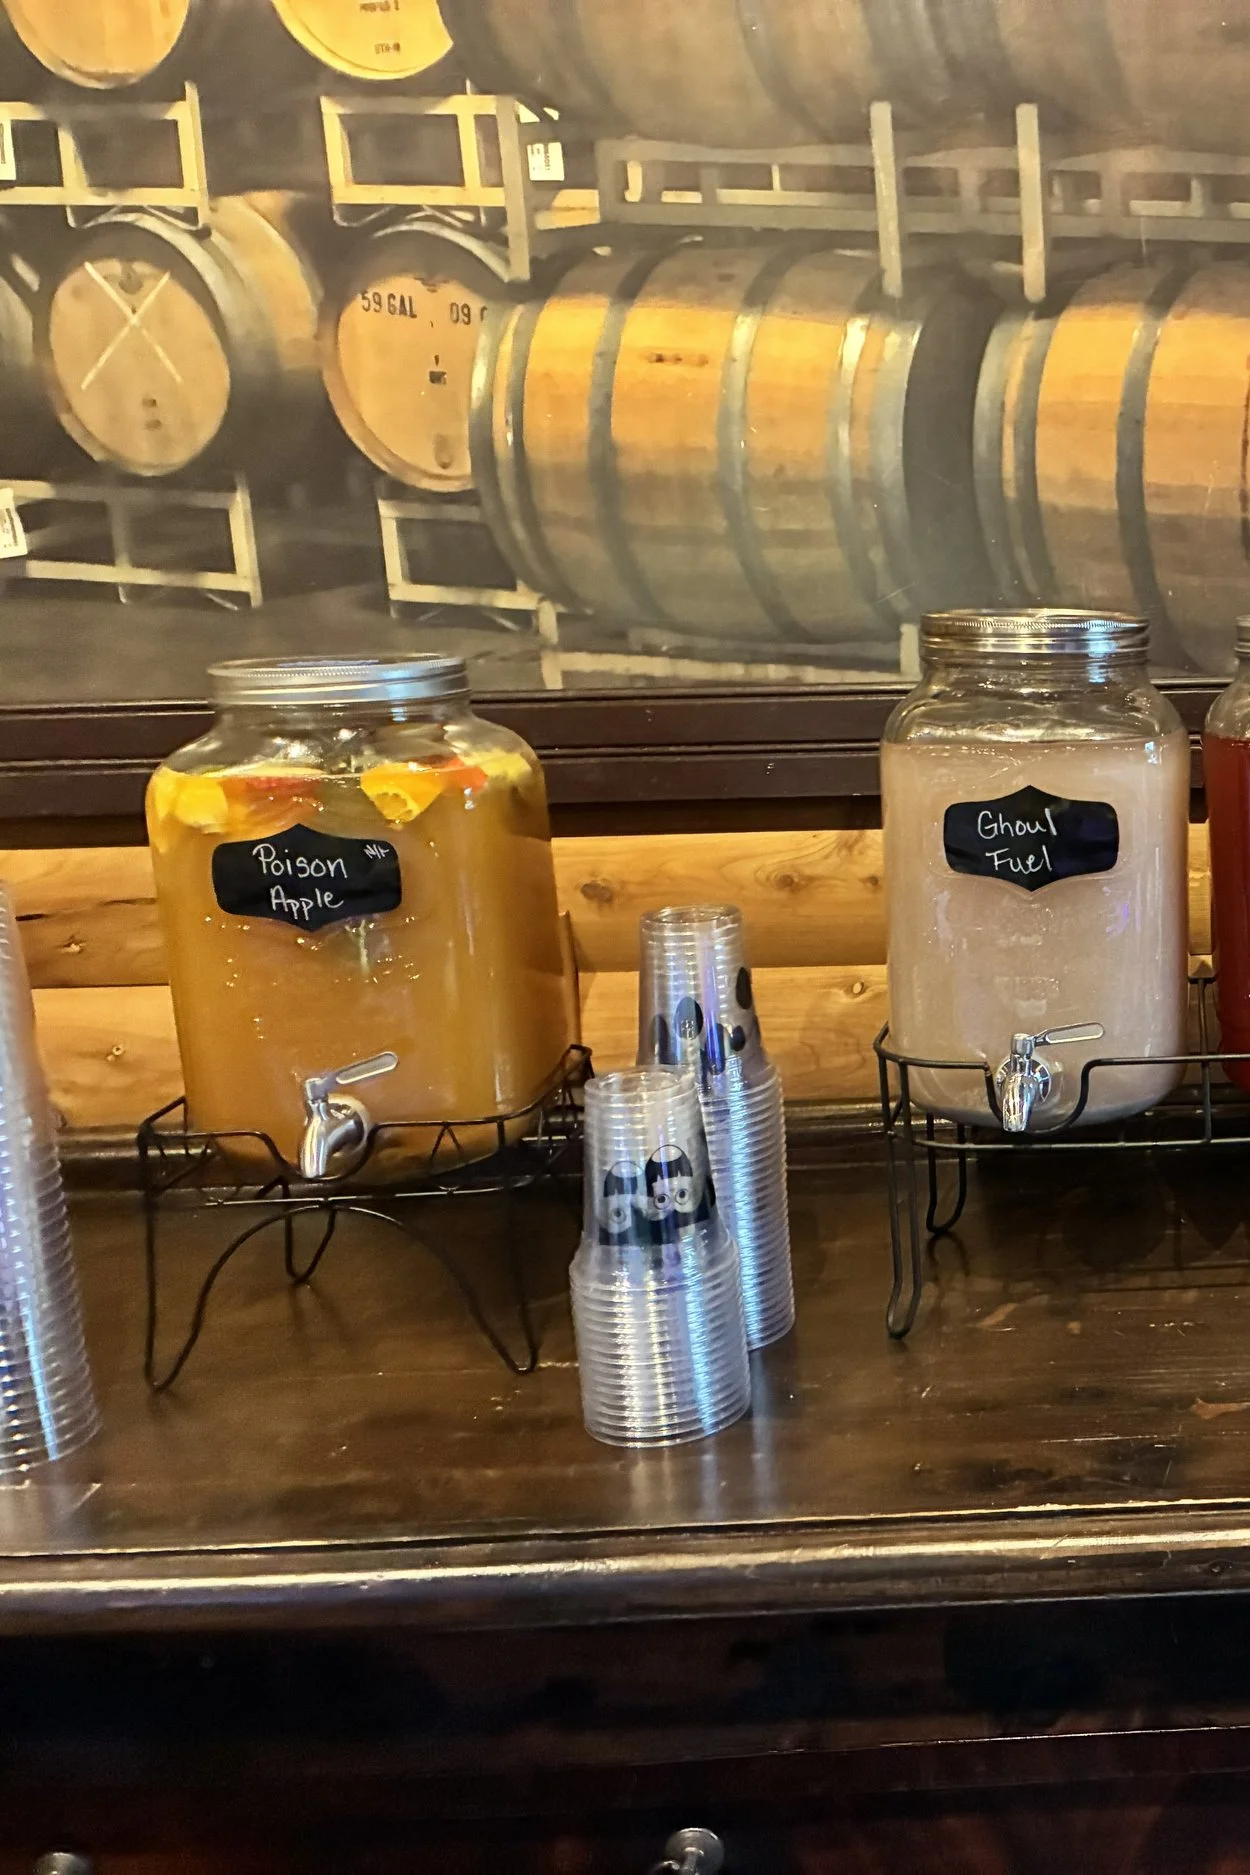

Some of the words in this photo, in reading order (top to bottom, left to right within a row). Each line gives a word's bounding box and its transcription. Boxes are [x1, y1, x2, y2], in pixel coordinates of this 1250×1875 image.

[361, 290, 382, 313] 59
[387, 293, 417, 319] GAL
[977, 807, 1058, 840] Ghoul
[252, 843, 348, 879] Poison
[985, 844, 1053, 875] Fuel
[269, 884, 344, 921] Apple
